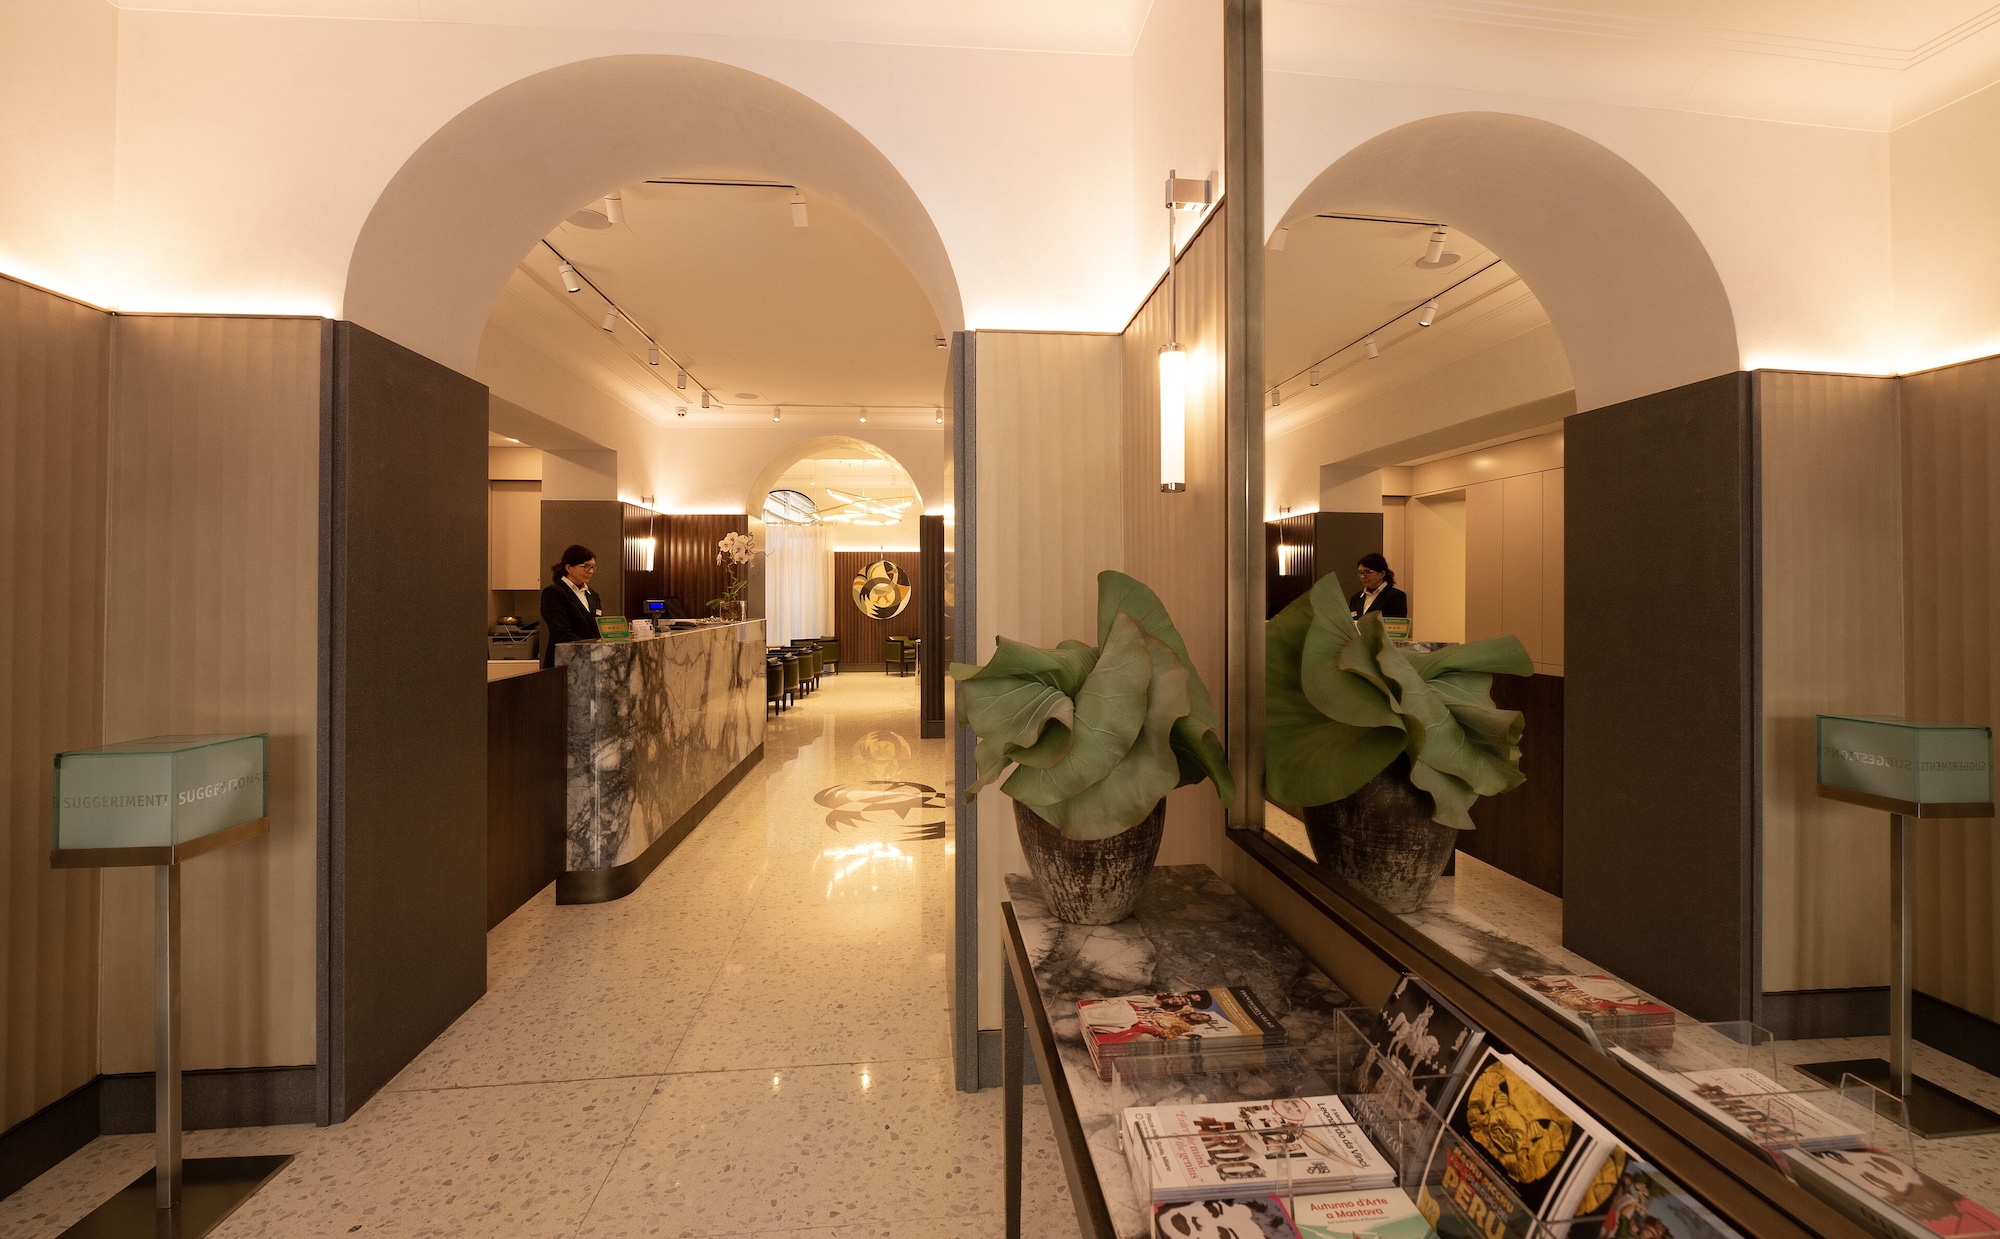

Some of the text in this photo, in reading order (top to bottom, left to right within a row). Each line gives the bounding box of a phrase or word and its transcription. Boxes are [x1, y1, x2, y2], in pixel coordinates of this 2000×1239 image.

[63, 794, 168, 809] SUGGERIMENTI
[1342, 1139, 1354, 1149] da
[1190, 1145, 1210, 1169] mind
[1310, 1197, 1389, 1211] Autunno d'Arte
[1335, 1207, 1384, 1219] Mantova
